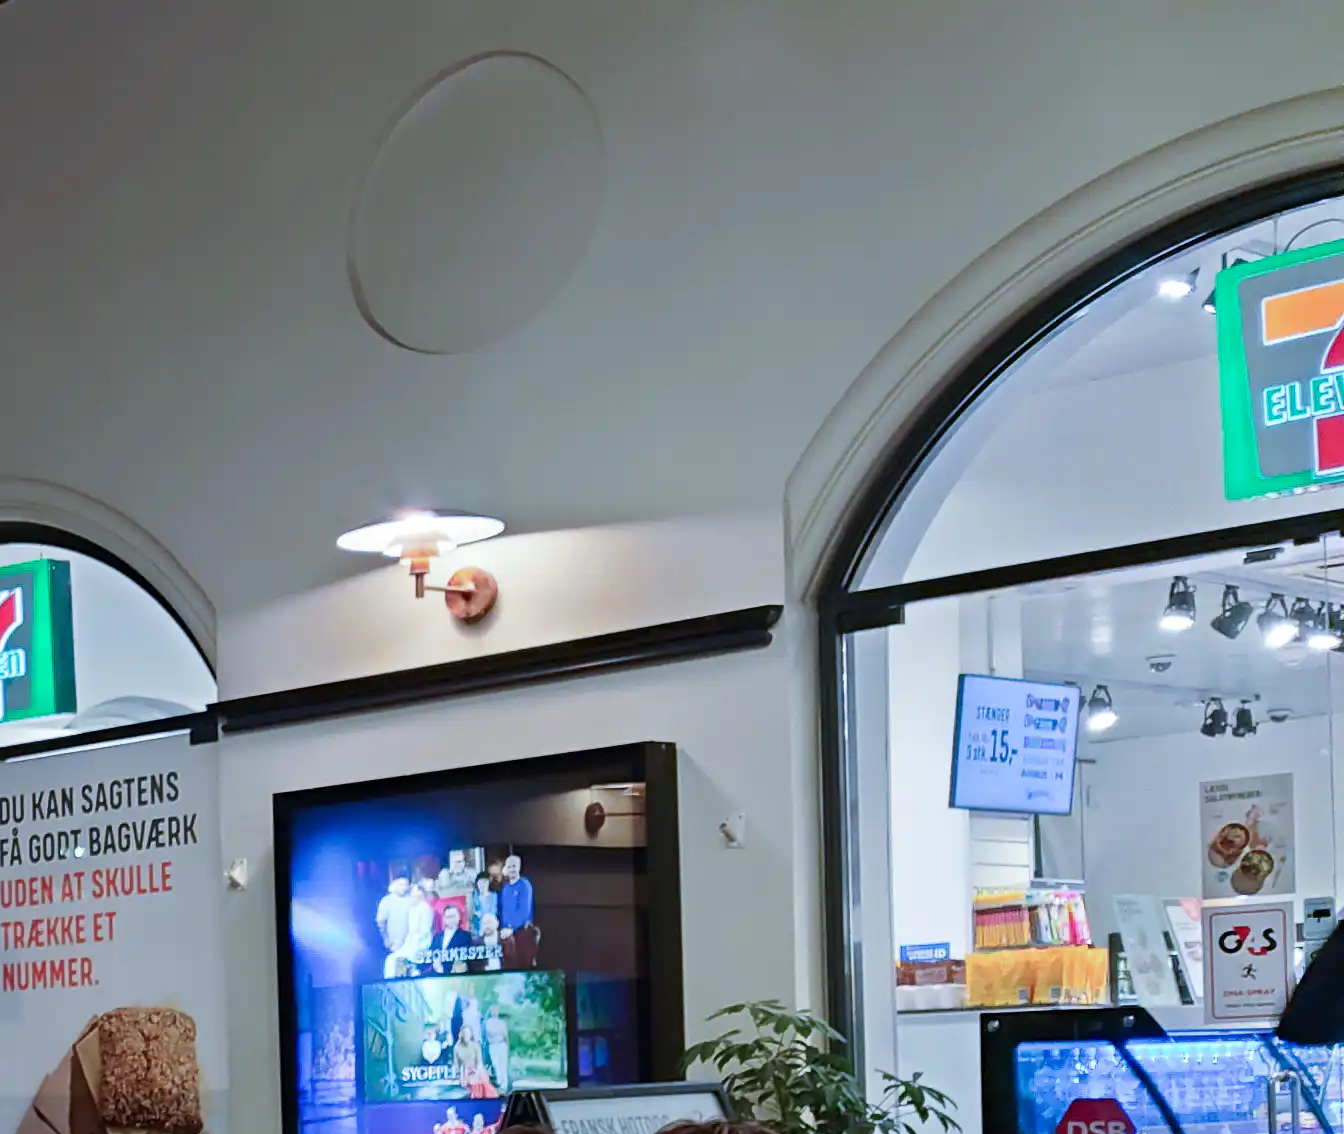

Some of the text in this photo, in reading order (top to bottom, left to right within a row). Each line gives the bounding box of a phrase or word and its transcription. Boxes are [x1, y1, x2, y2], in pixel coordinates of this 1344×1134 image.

[31, 787, 74, 821] KAN
[81, 771, 180, 814] SAGTENS
[0, 813, 198, 867] FÅ GODT BAGVÆRK
[0, 861, 173, 908] UDEN AT SKULLE
[0, 911, 117, 951] TRÆKKE ET
[2, 957, 100, 992] NUMMER.
